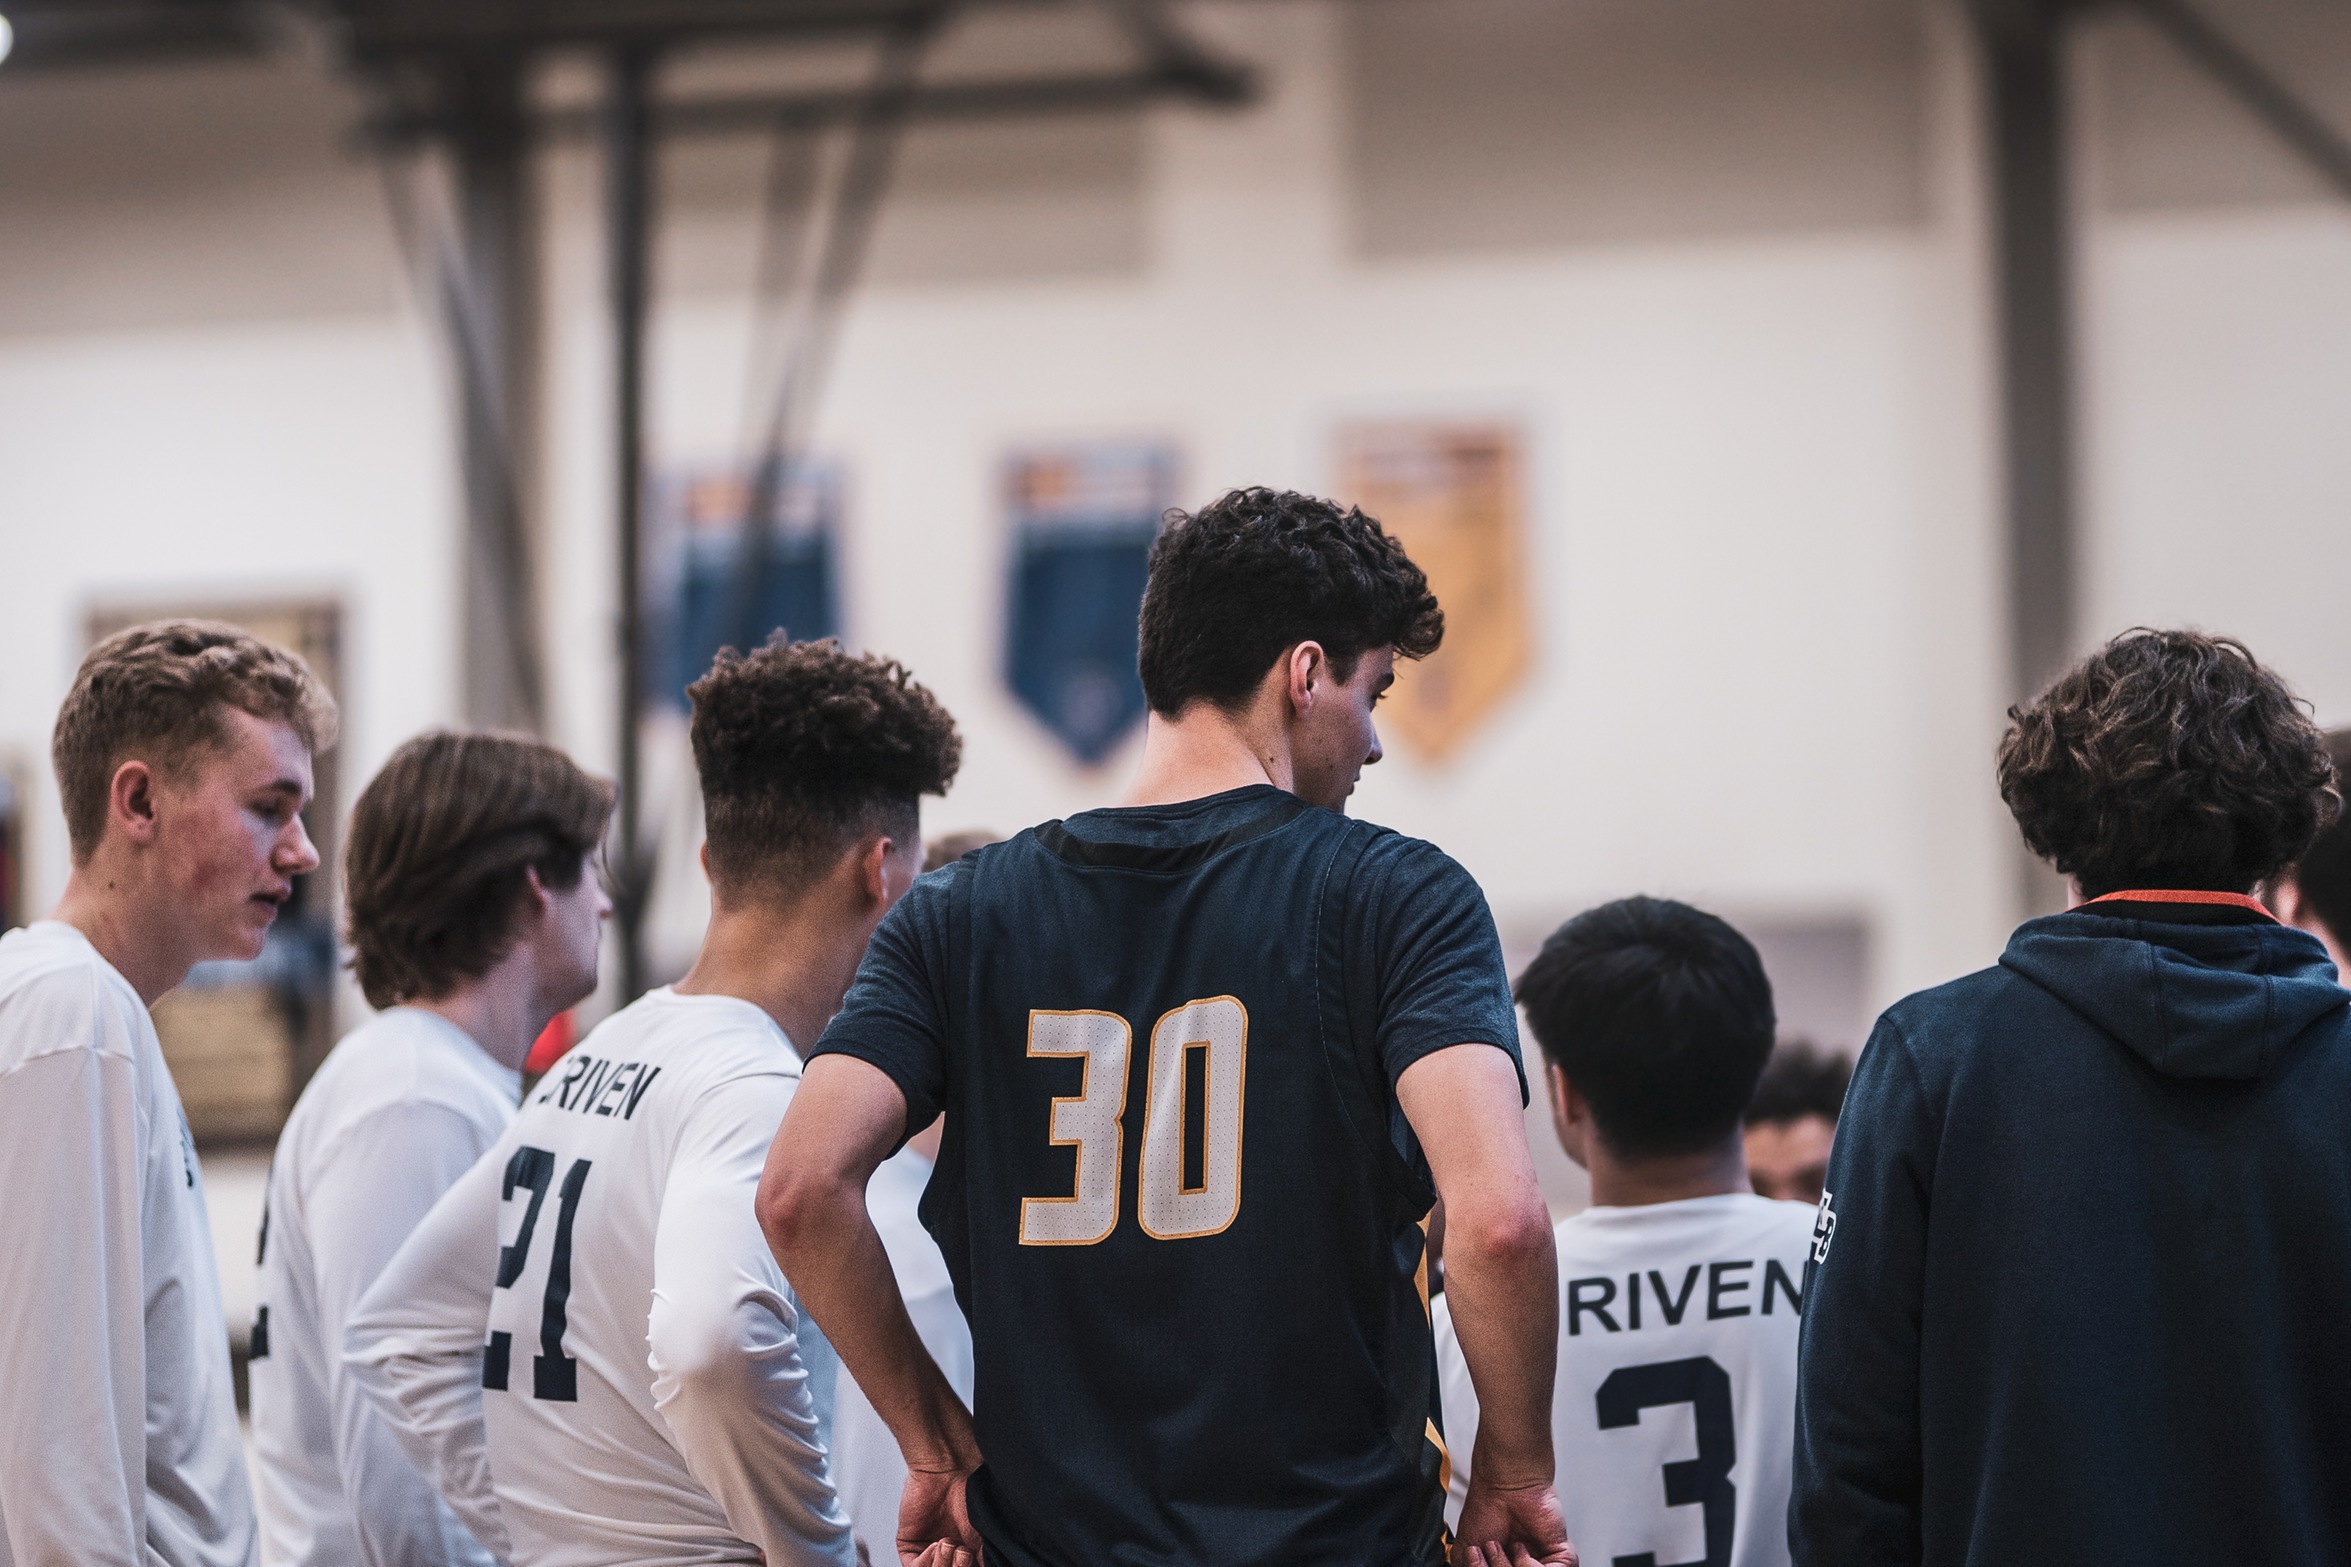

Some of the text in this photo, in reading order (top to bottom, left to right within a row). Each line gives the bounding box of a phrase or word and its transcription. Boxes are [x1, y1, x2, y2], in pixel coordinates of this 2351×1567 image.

[1019, 995, 1248, 1246] 30
[482, 1146, 593, 1403] 21
[1568, 1259, 1809, 1336] RIVEN
[1596, 1355, 1737, 1567] 3
